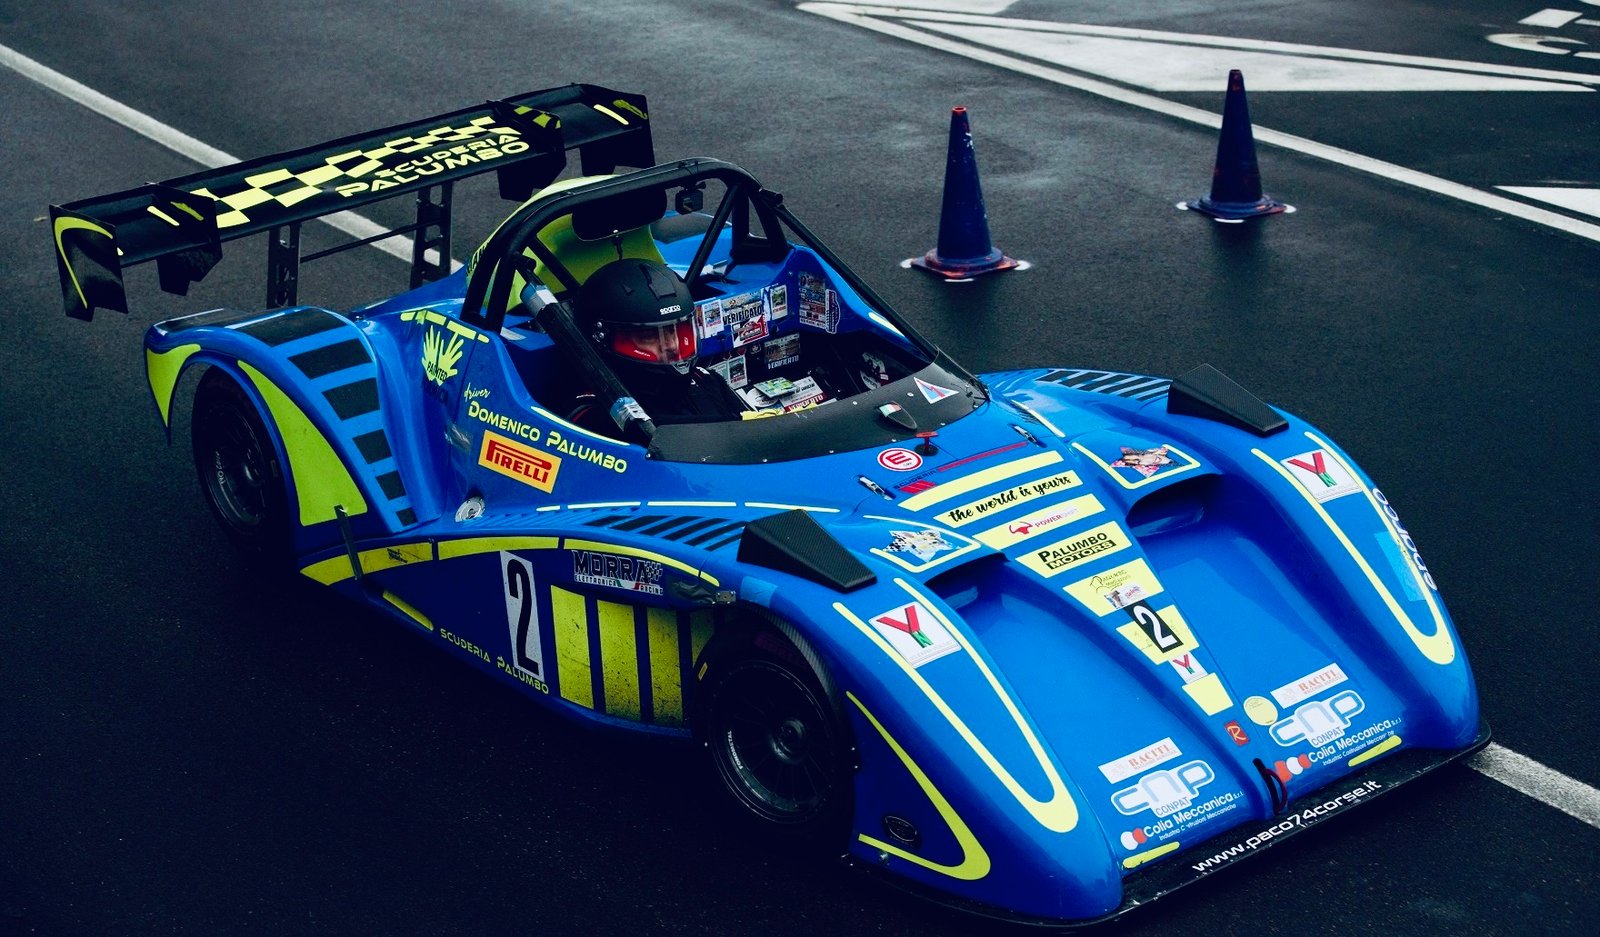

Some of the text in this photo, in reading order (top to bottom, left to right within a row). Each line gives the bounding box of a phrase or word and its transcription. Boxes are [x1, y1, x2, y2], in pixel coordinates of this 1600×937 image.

[335, 141, 530, 198] PALUMBO
[374, 134, 520, 178] SCUDERIA
[722, 304, 763, 326] VERIFICATO
[464, 382, 490, 402] driver
[468, 400, 628, 474] DOMENICO PALUMBO
[485, 439, 553, 484] PIRELLI
[948, 475, 1072, 522] the world is yours
[571, 549, 650, 583] MORRA
[1038, 532, 1108, 562] PALUMBO
[1047, 541, 1115, 569] MOTORS
[506, 558, 540, 676] 2
[1133, 605, 1178, 649] 2
[440, 628, 549, 695] SCUDERIA PALUMBO
[1308, 744, 1336, 763] Colia
[1335, 719, 1391, 750] Meccanica
[1311, 726, 1344, 746] CONPAT
[1143, 818, 1174, 838] Colia
[1172, 792, 1234, 825] Meccanica
[1155, 796, 1190, 817] CONPAT
[1192, 779, 1382, 872] www.paco74corse.it
